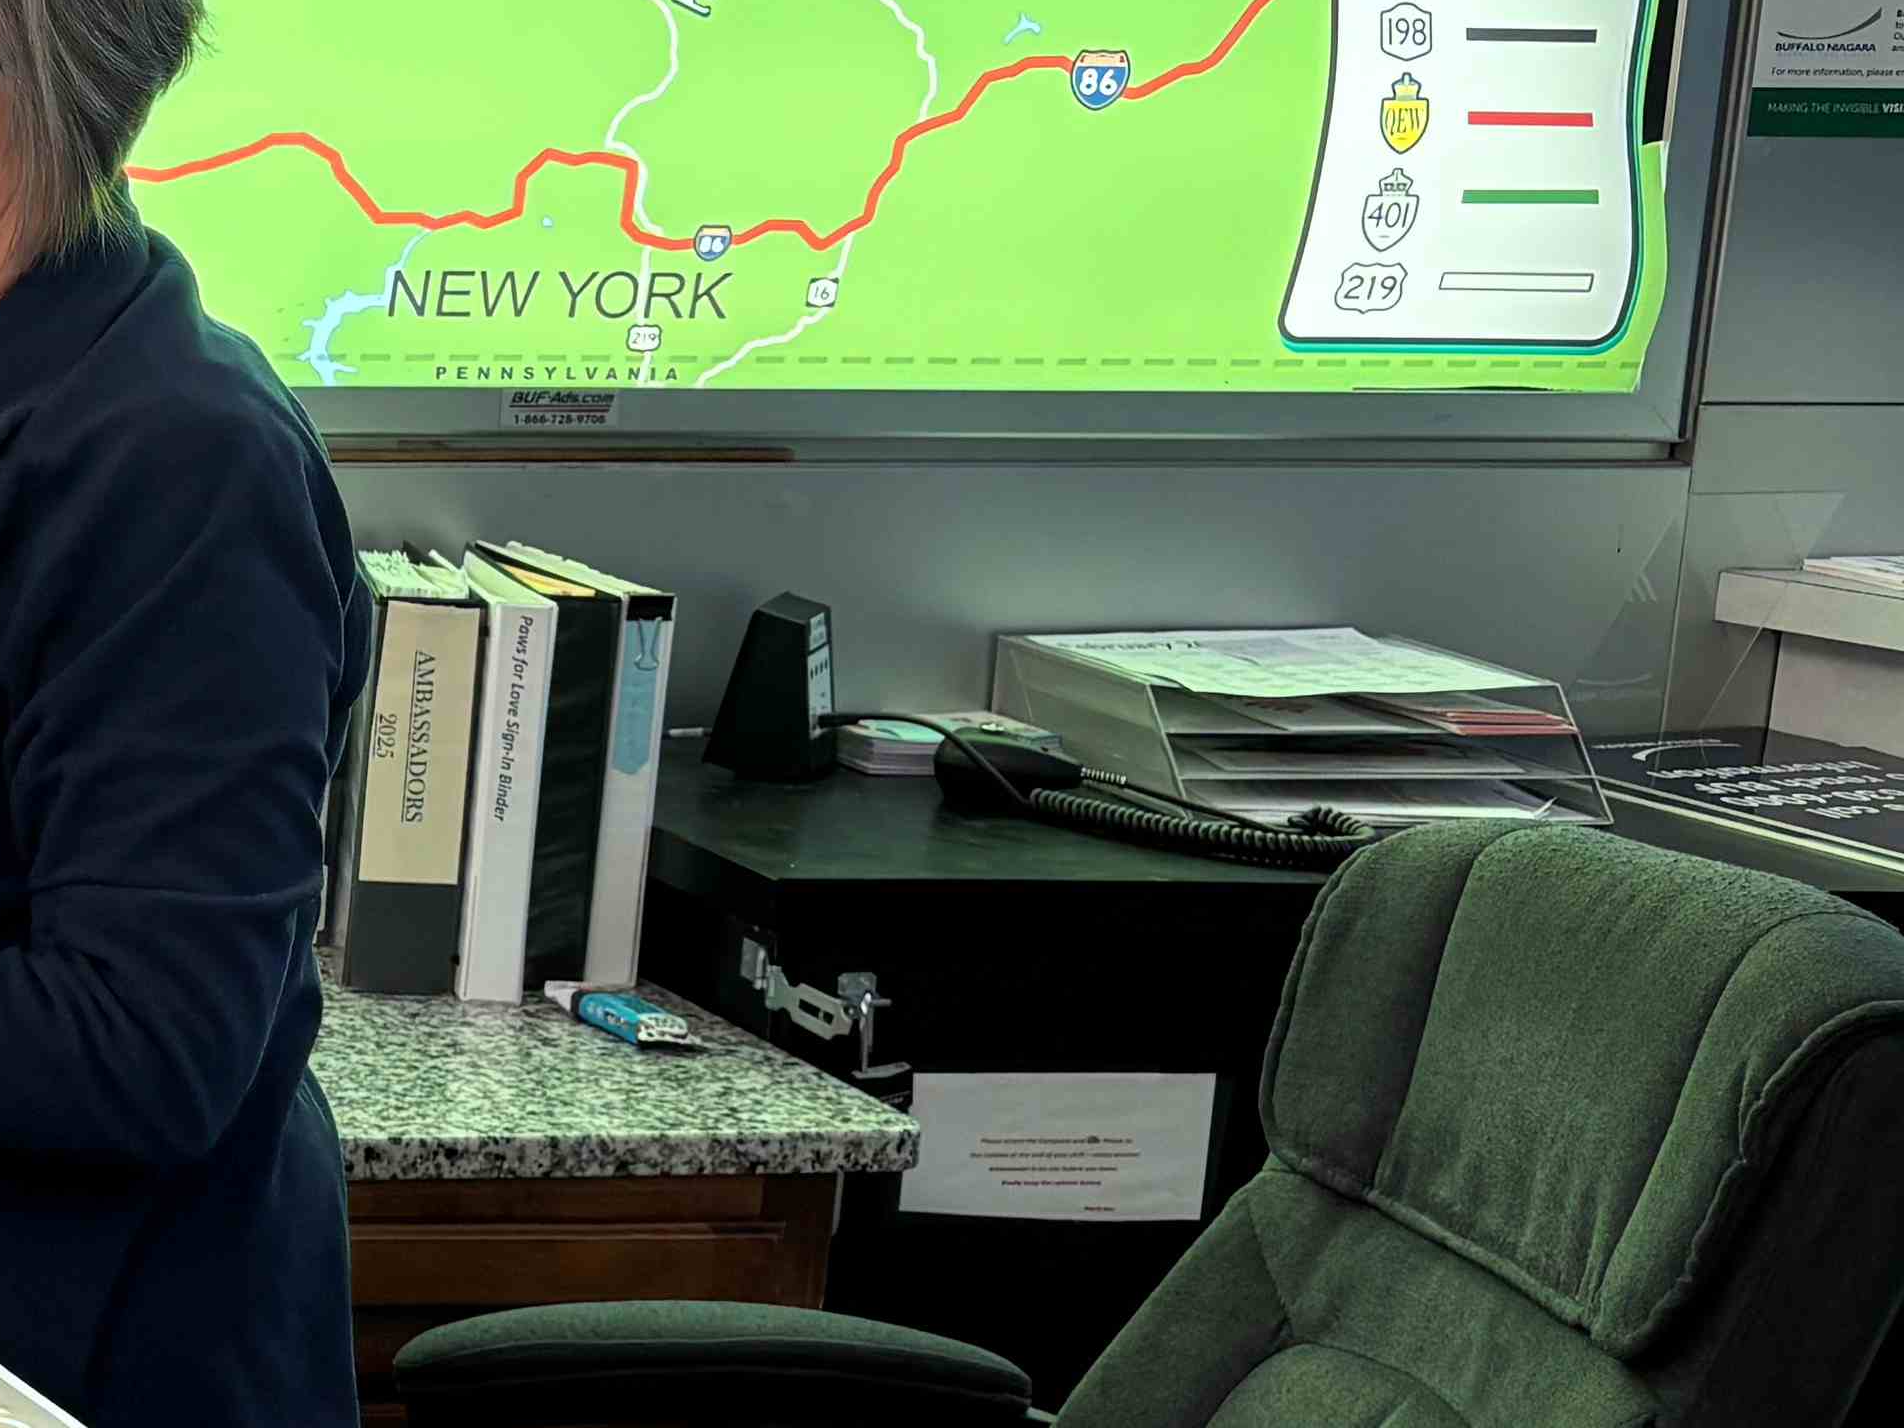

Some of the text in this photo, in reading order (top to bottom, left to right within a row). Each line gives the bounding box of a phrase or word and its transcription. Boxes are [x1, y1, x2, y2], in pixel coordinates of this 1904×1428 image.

[1775, 43, 1876, 52] BUFFALO NIAGARA
[1079, 67, 1117, 99] 86
[386, 270, 734, 320] NEW YORK
[434, 366, 679, 381] PENNSYLVANIA
[375, 713, 397, 759] 2025
[405, 650, 436, 824] AMBASSADORS
[493, 616, 534, 822] Paws for Love Sign-In Binder
